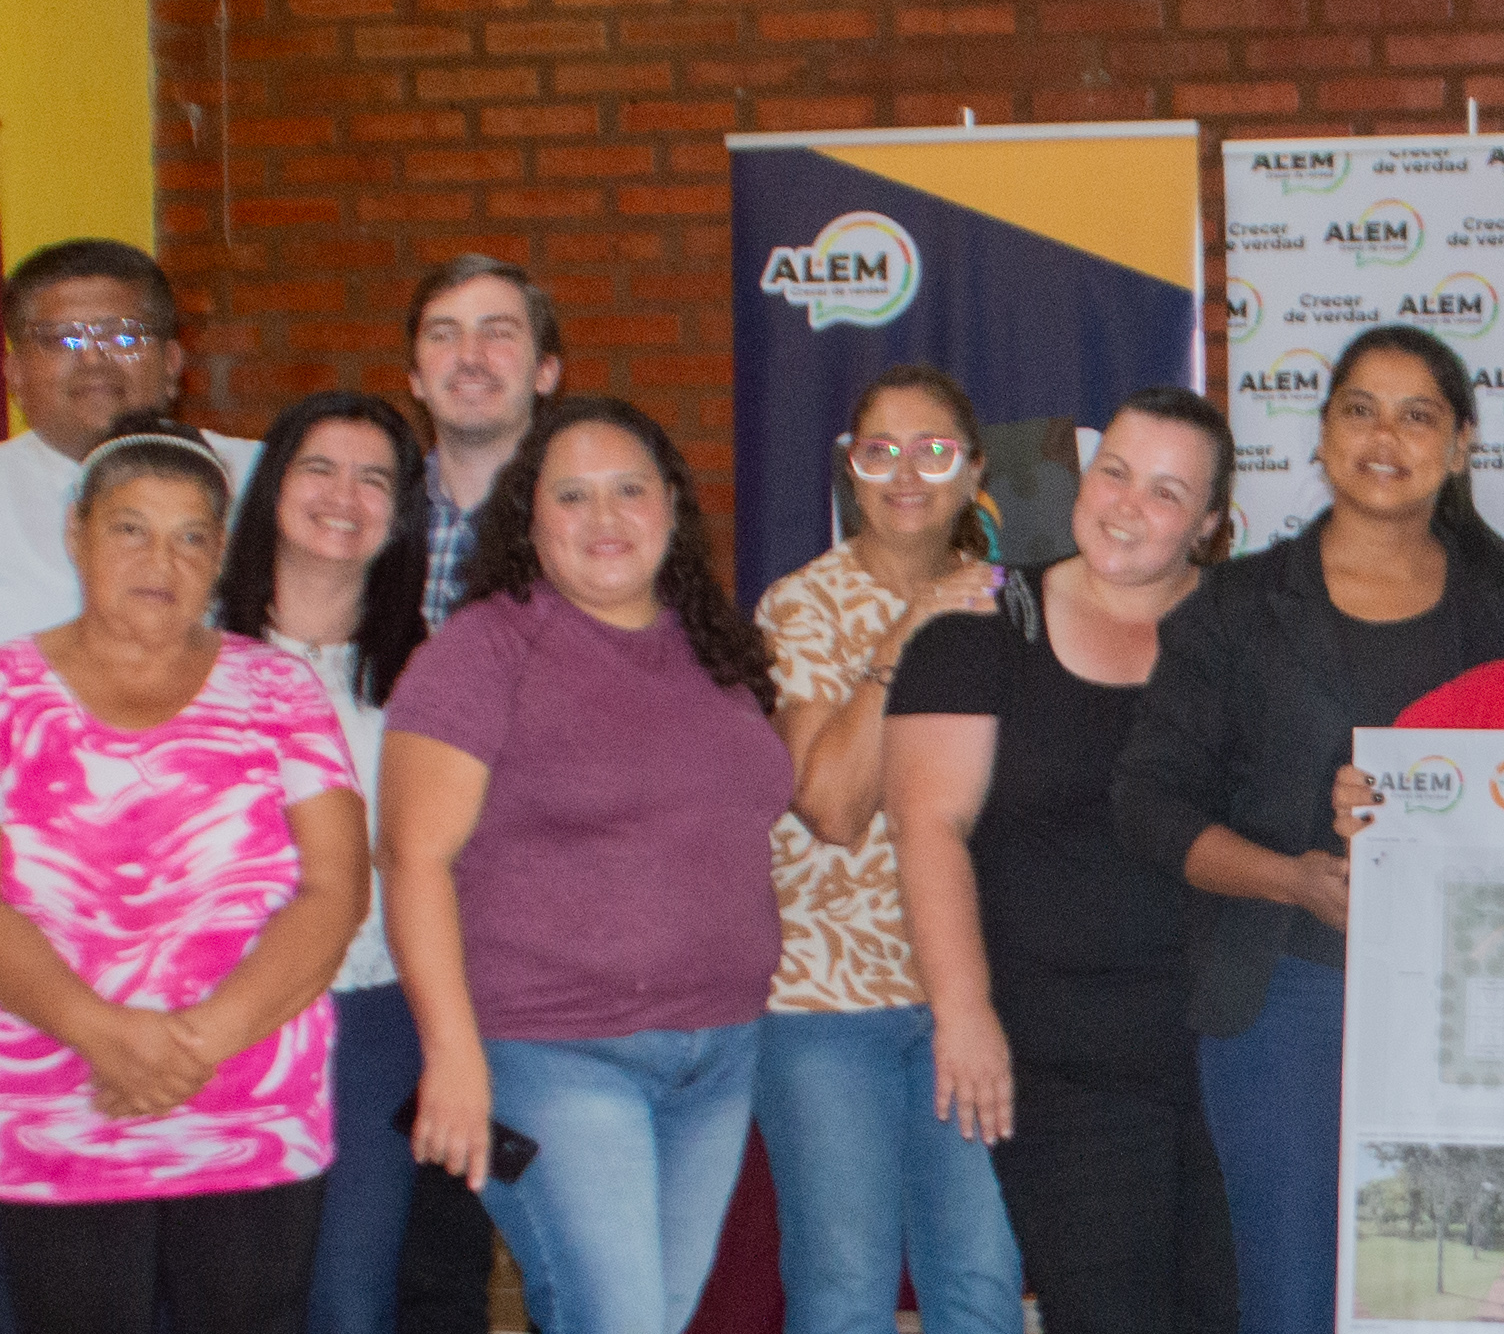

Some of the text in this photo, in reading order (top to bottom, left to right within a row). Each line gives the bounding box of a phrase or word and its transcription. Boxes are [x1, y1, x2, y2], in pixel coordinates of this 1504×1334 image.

[1251, 151, 1334, 170] ALEM
[1372, 157, 1469, 173] de verdad
[1228, 222, 1288, 236] Crecer
[1324, 220, 1408, 243] ALEM
[1244, 235, 1305, 250] verdad
[1447, 232, 1470, 247] de
[770, 251, 889, 284] ALEM
[1299, 292, 1362, 308] Crecer
[1397, 293, 1483, 315] ALEM
[1283, 307, 1380, 323] de verdad
[1238, 369, 1319, 392] ALEM
[1236, 444, 1273, 456] ecer
[1236, 455, 1289, 472] erdad
[1379, 771, 1452, 792] ALEM
